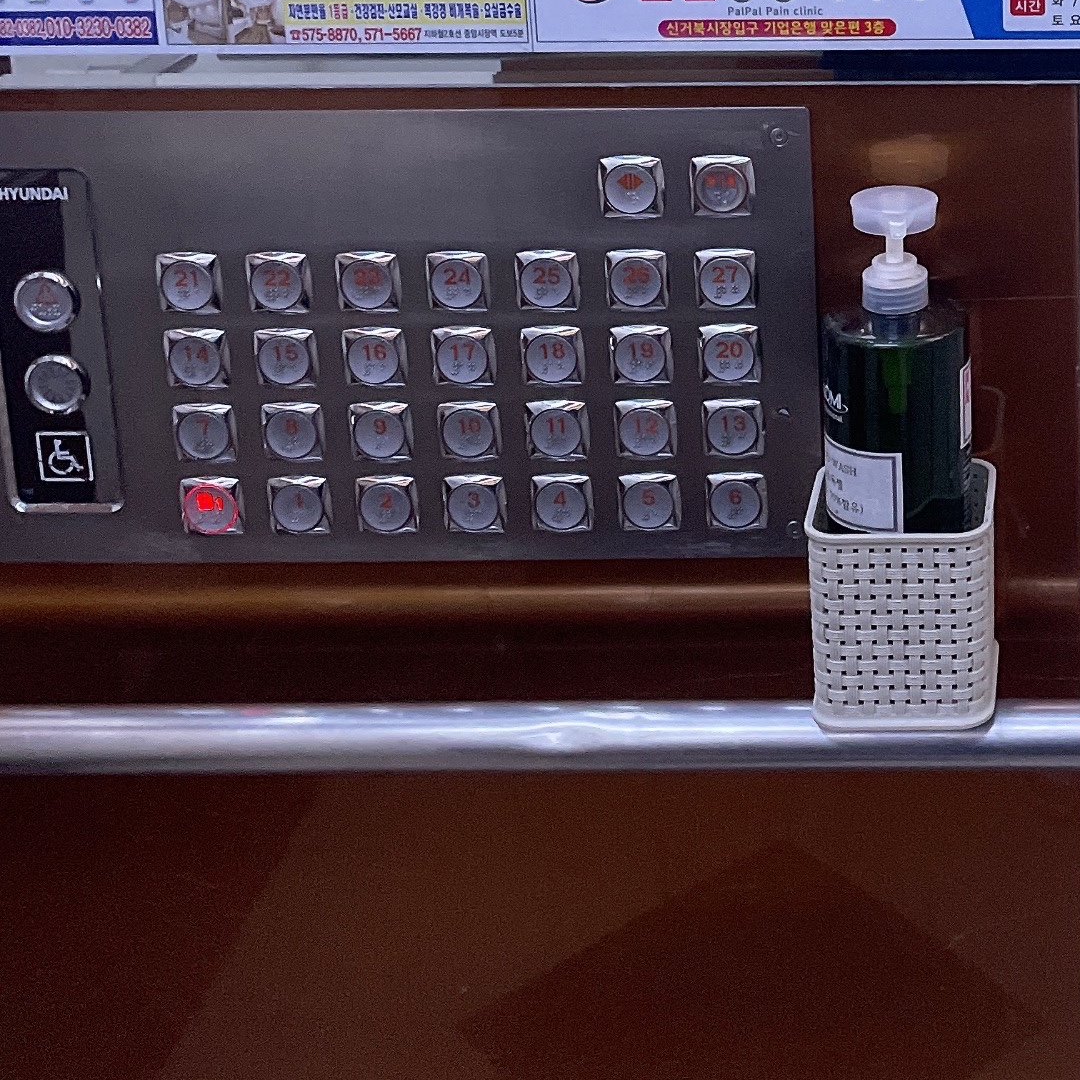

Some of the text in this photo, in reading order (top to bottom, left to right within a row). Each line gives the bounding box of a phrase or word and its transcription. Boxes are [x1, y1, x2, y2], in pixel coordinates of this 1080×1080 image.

[728, 7, 824, 16] PalPal Pain clinic
[1015, 0, 1041, 13] 시간
[364, 27, 422, 41] 571-5667
[666, 21, 885, 36] 신거북시장입구 기업은행 맞은편 3층
[0, 186, 69, 201] HYUNDAI
[174, 270, 198, 287] 21
[264, 270, 290, 287] 22
[443, 269, 471, 286] 24
[533, 268, 560, 285] 25
[711, 267, 739, 283] 27
[184, 345, 209, 364] 14
[273, 344, 298, 362] 15
[362, 344, 387, 361] 16
[449, 344, 475, 361] 17
[539, 343, 566, 360] 18
[628, 342, 654, 359] 19
[716, 342, 743, 359] 20
[374, 419, 387, 435] 9
[546, 418, 566, 434] 11
[721, 416, 747, 432] 13
[467, 492, 480, 508] 3
[553, 491, 565, 507] 4
[728, 490, 742, 506] 6
